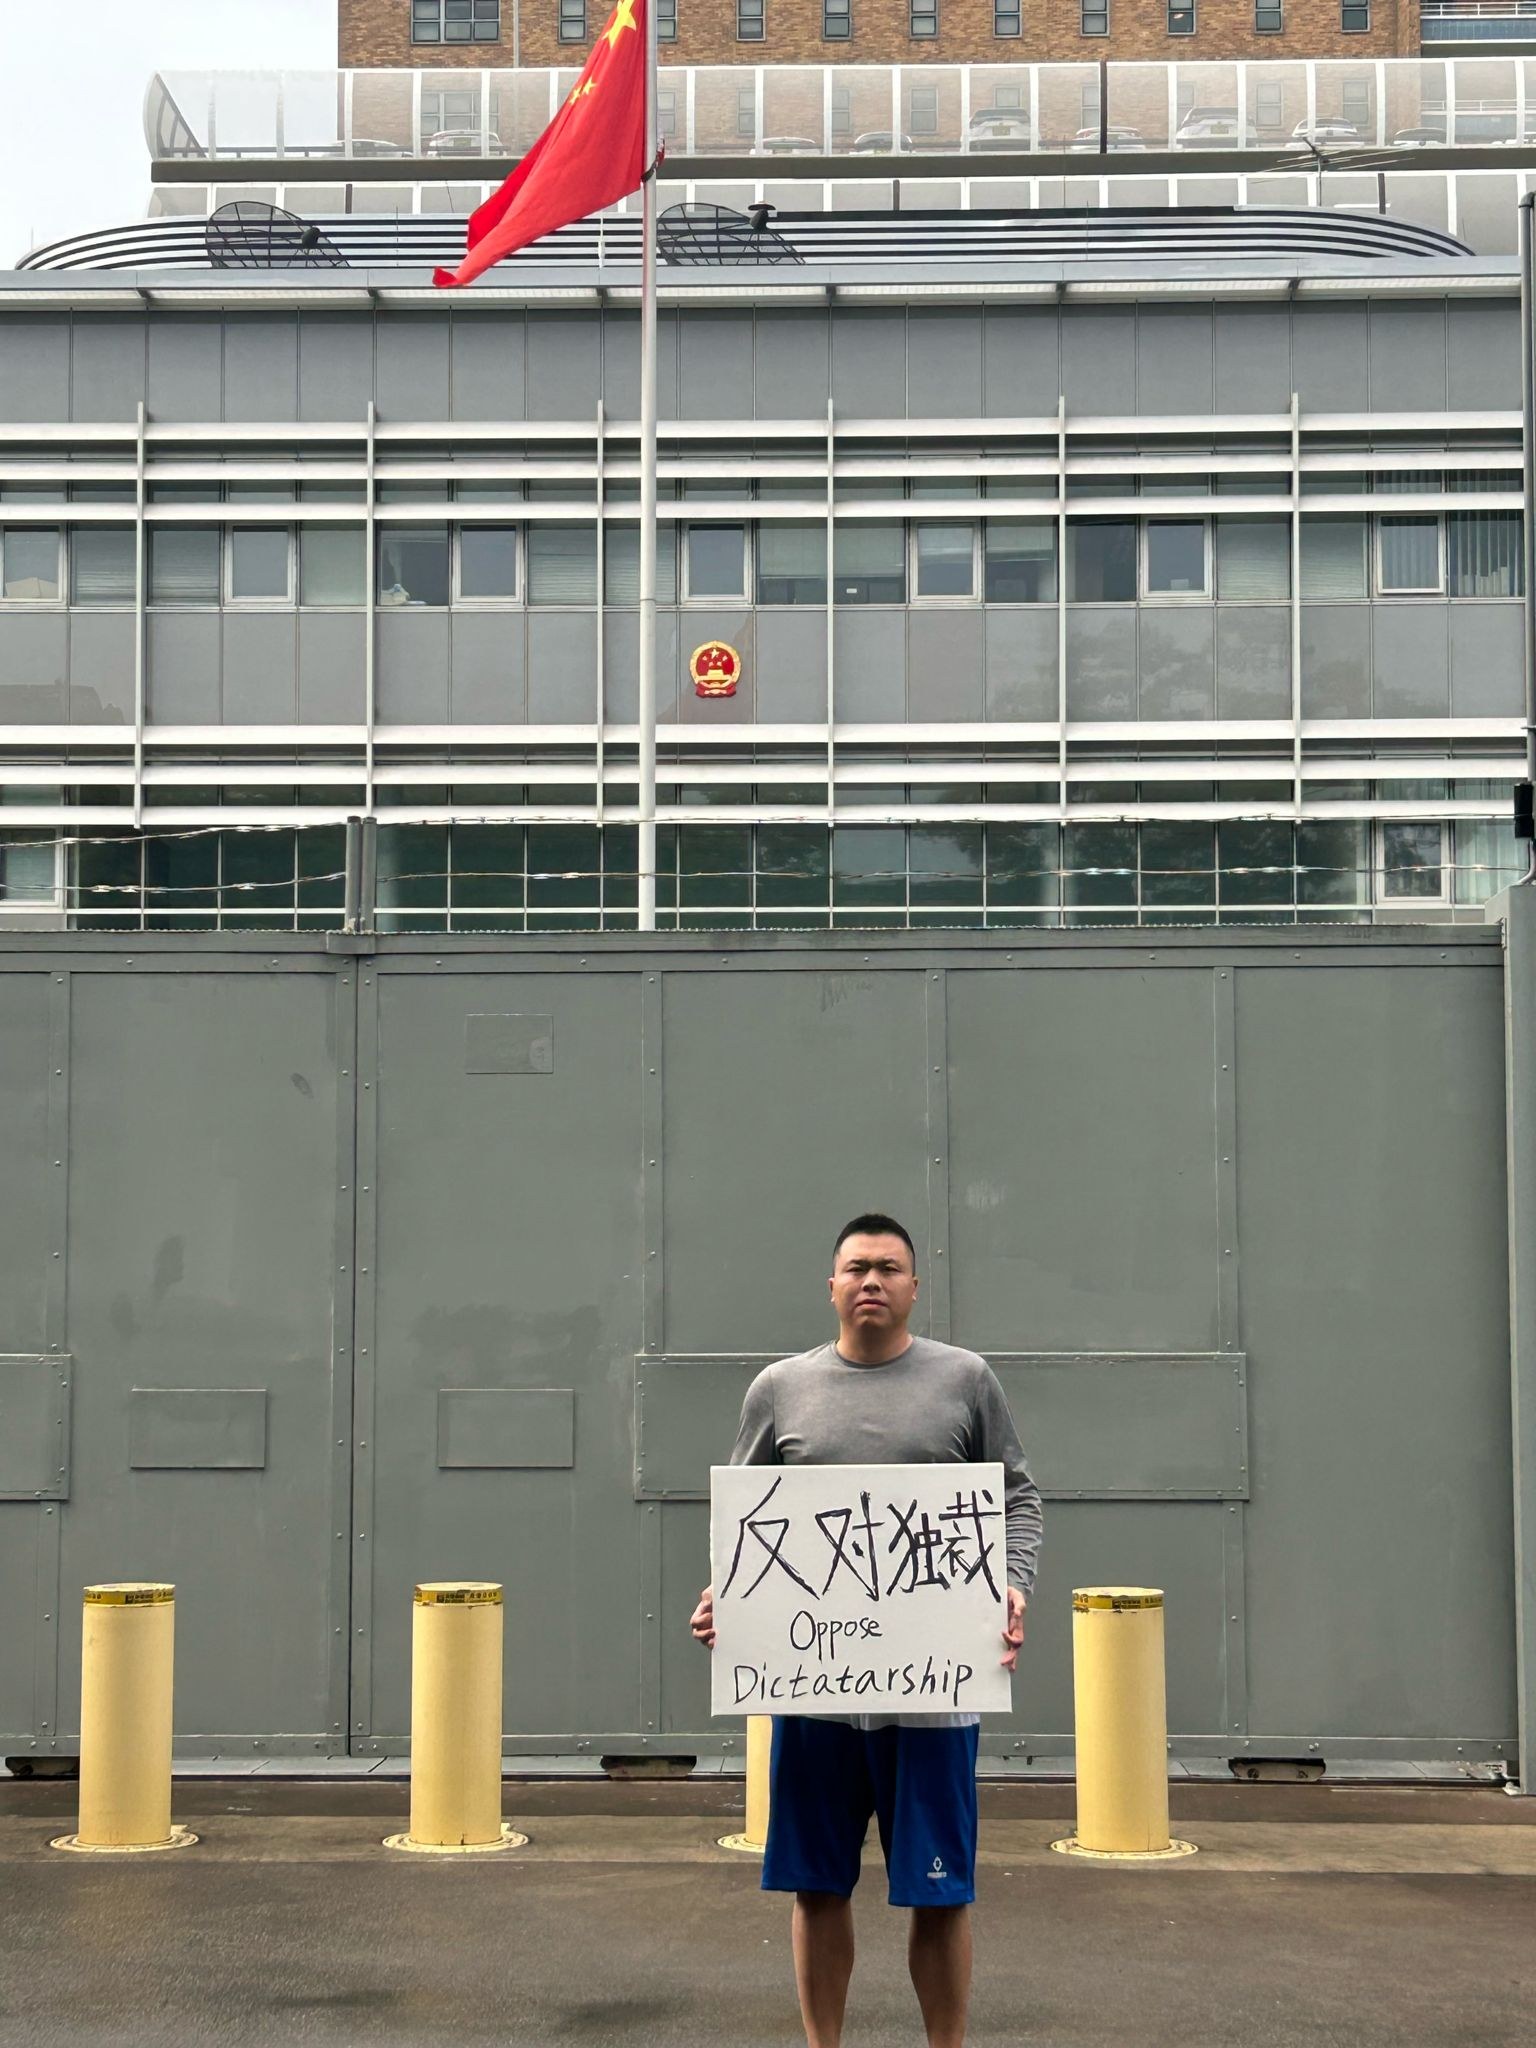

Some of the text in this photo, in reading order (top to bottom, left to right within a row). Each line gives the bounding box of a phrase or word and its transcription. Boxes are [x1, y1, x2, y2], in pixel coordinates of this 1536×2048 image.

[720, 1475, 1003, 1603] 反对独裁
[790, 1610, 883, 1661] Oppose
